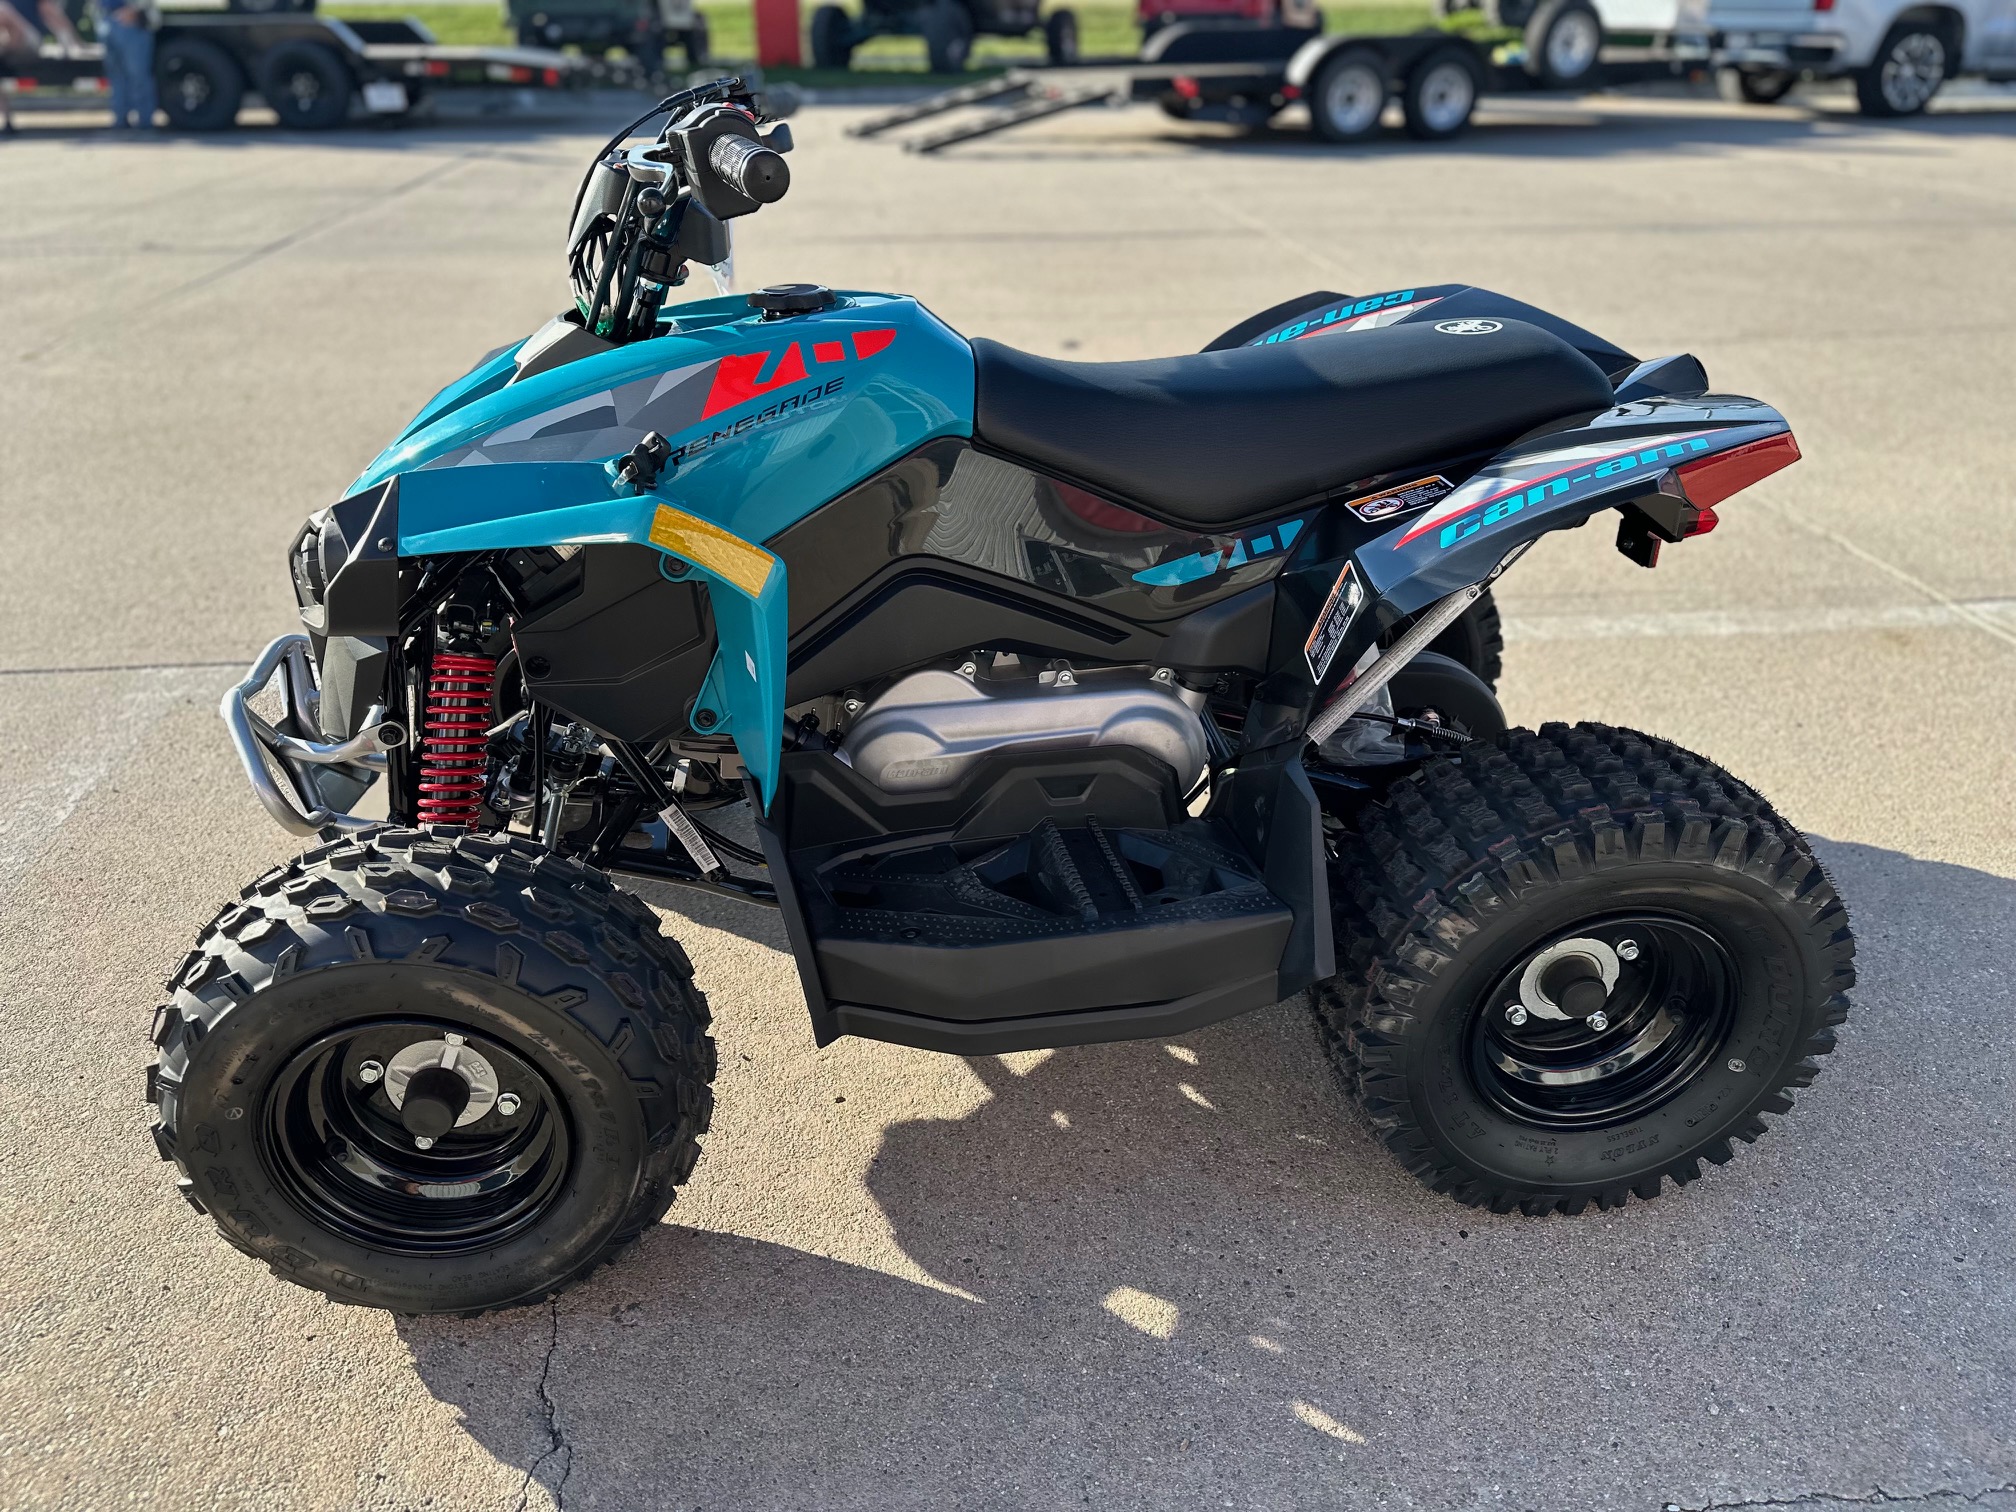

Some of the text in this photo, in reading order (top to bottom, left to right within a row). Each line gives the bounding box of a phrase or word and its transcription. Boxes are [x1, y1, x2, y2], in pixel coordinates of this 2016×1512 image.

[659, 376, 846, 473] RENEGADE
[1439, 436, 1710, 549] can-am
[1599, 1133, 1661, 1163] NYLON
[1605, 1125, 1645, 1143] TUBELESS
